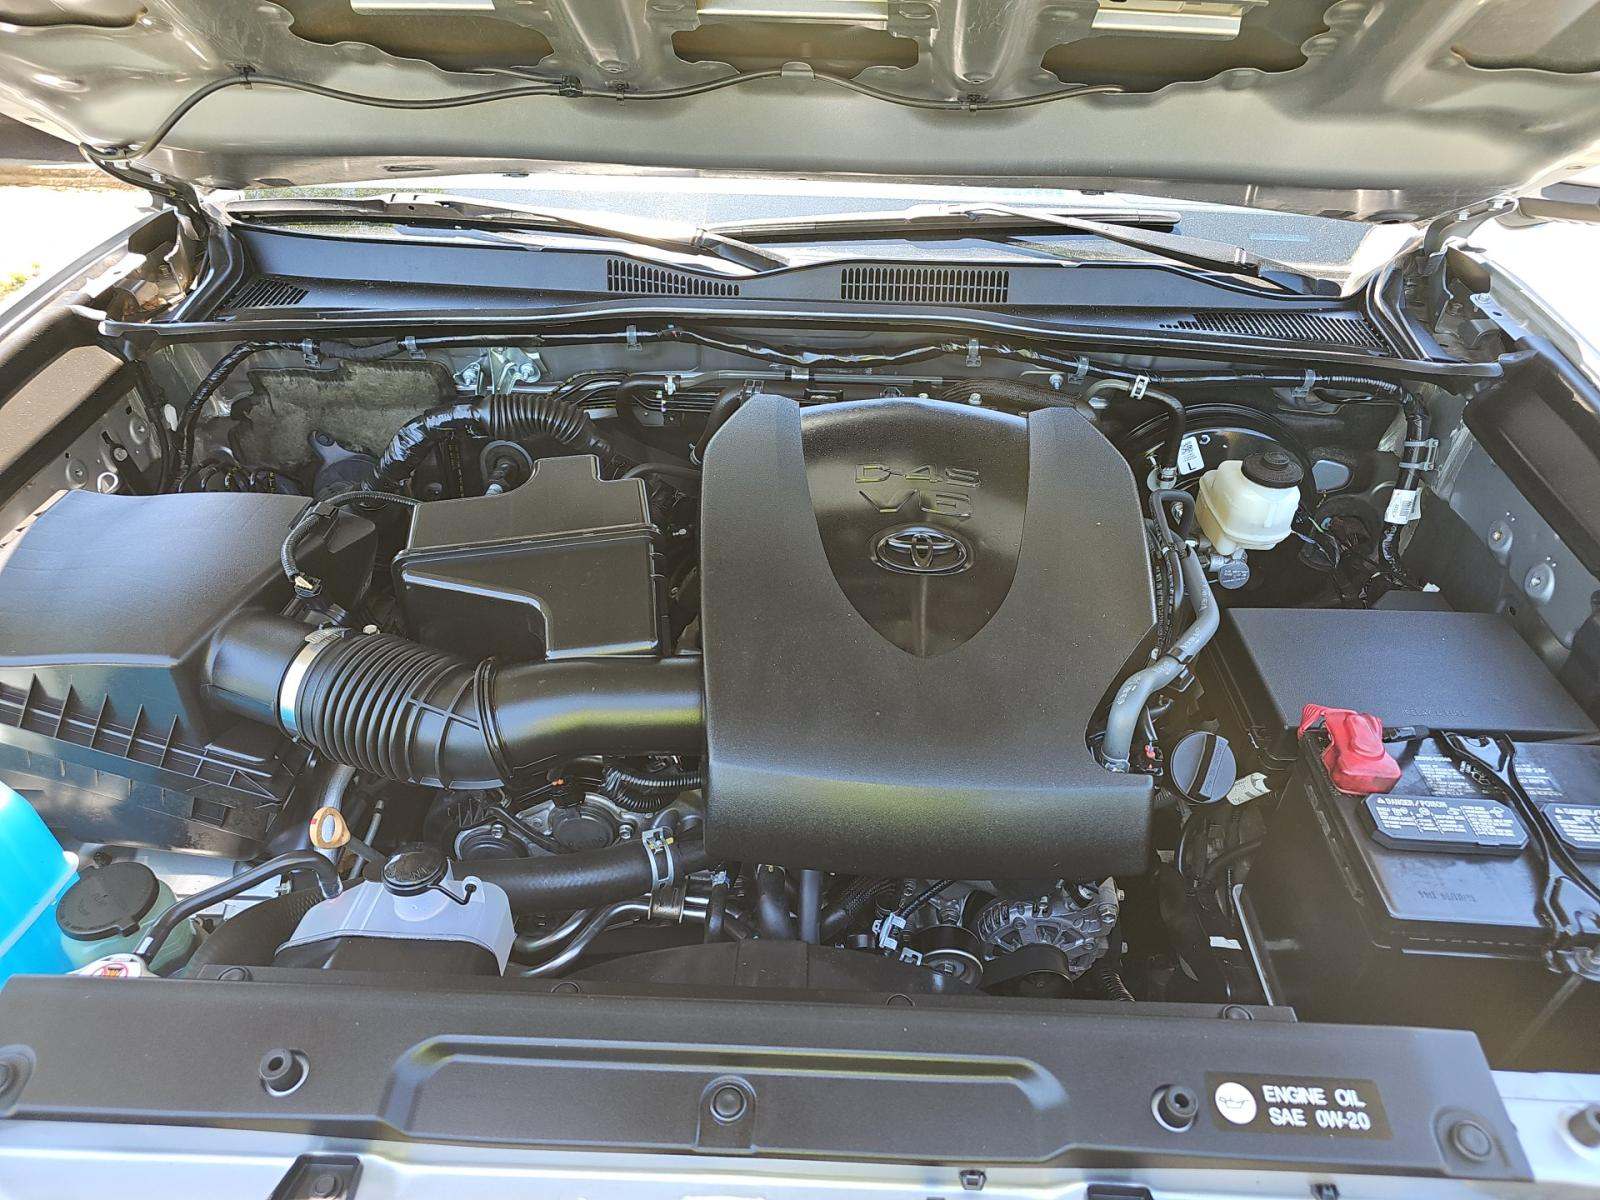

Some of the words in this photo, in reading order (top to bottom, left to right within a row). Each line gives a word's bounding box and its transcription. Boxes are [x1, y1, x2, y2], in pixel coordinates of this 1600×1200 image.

[859, 488, 974, 519] V6
[1262, 1085, 1328, 1106] ENGINE
[1334, 1088, 1366, 1108] OIL
[1268, 1107, 1307, 1127] SAE
[1315, 1109, 1371, 1131] 0W-20
